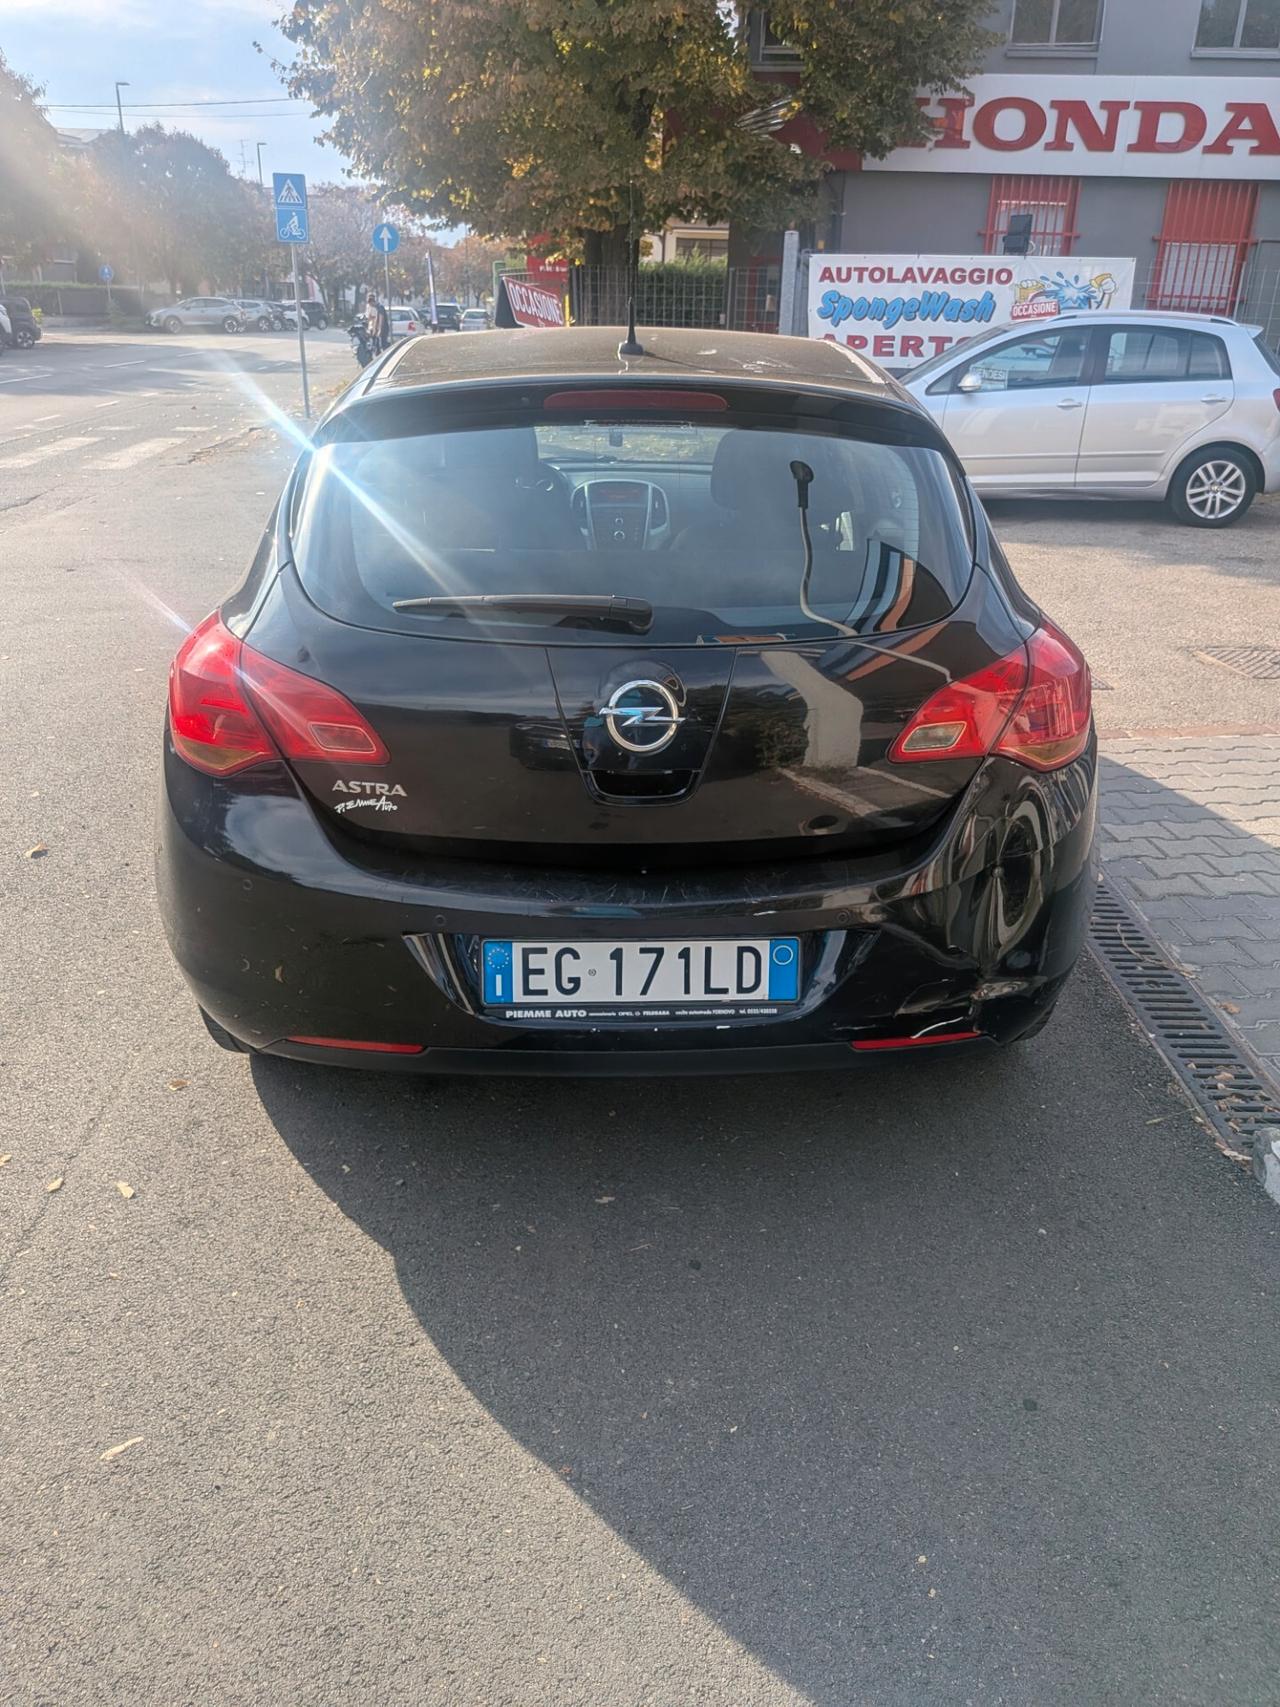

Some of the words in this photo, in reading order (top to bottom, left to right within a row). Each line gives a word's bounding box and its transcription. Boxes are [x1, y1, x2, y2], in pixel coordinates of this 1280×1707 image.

[897, 96, 1280, 156] HONDA
[818, 266, 1014, 285] AUTOLAVAGGIO
[508, 282, 564, 325] OCCASIONE
[816, 289, 997, 330] SpongeWash
[1012, 302, 1057, 316] OCCASIONE
[332, 780, 408, 797] ASTRA
[521, 946, 582, 997] EG
[609, 945, 763, 997] 171LD
[505, 1010, 552, 1018] PIEMME
[555, 1010, 587, 1018] AUTO
